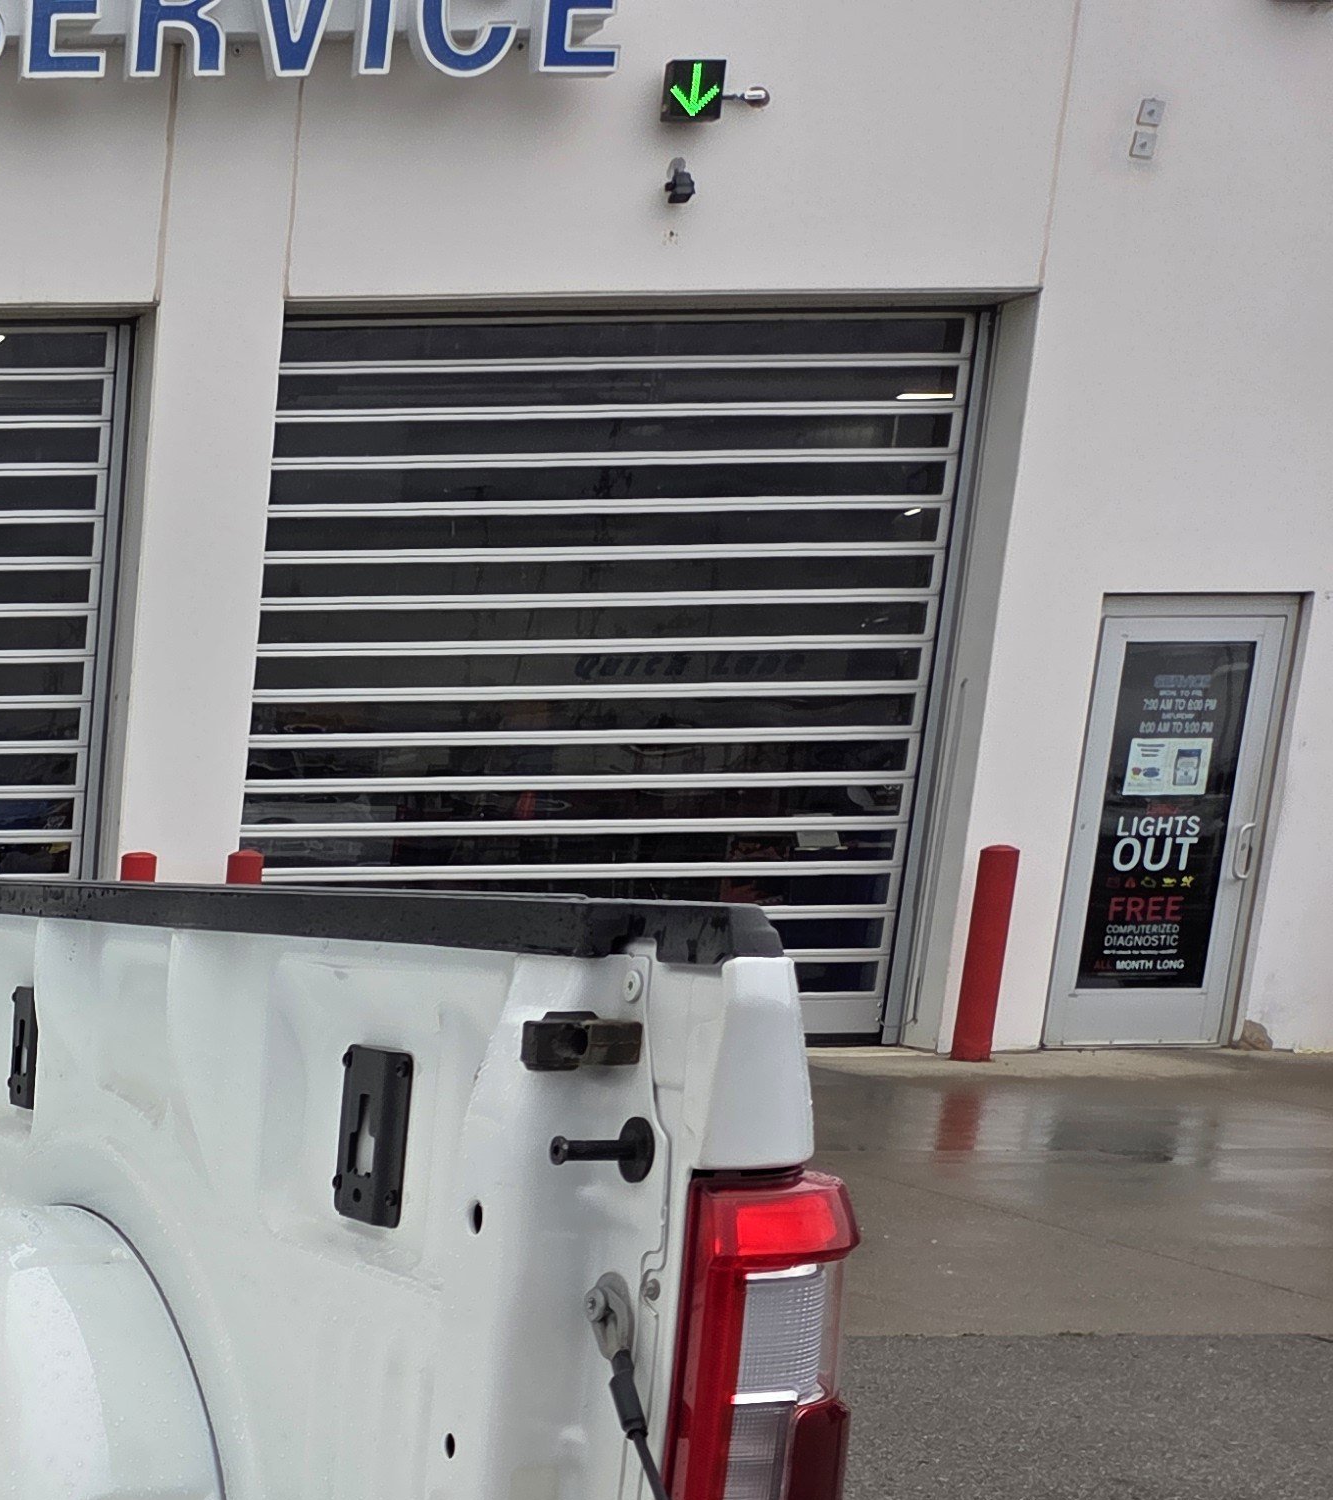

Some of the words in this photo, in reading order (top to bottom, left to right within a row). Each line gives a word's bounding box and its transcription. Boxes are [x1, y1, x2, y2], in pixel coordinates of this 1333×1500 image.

[1159, 698, 1173, 710] AM
[1175, 698, 1186, 710] TO
[1204, 698, 1217, 710] PM
[1157, 721, 1170, 733] AM
[1172, 721, 1183, 733] TO
[1200, 721, 1214, 733] PM
[1116, 815, 1201, 837] LIGHTS
[1112, 837, 1200, 872] OUT
[1108, 896, 1184, 922] FREE
[1106, 923, 1179, 934] COMPUTERIZED
[1104, 934, 1179, 946] DIAGNOSTIC
[1116, 960, 1153, 970] MONTH
[1156, 959, 1184, 970] LONG
